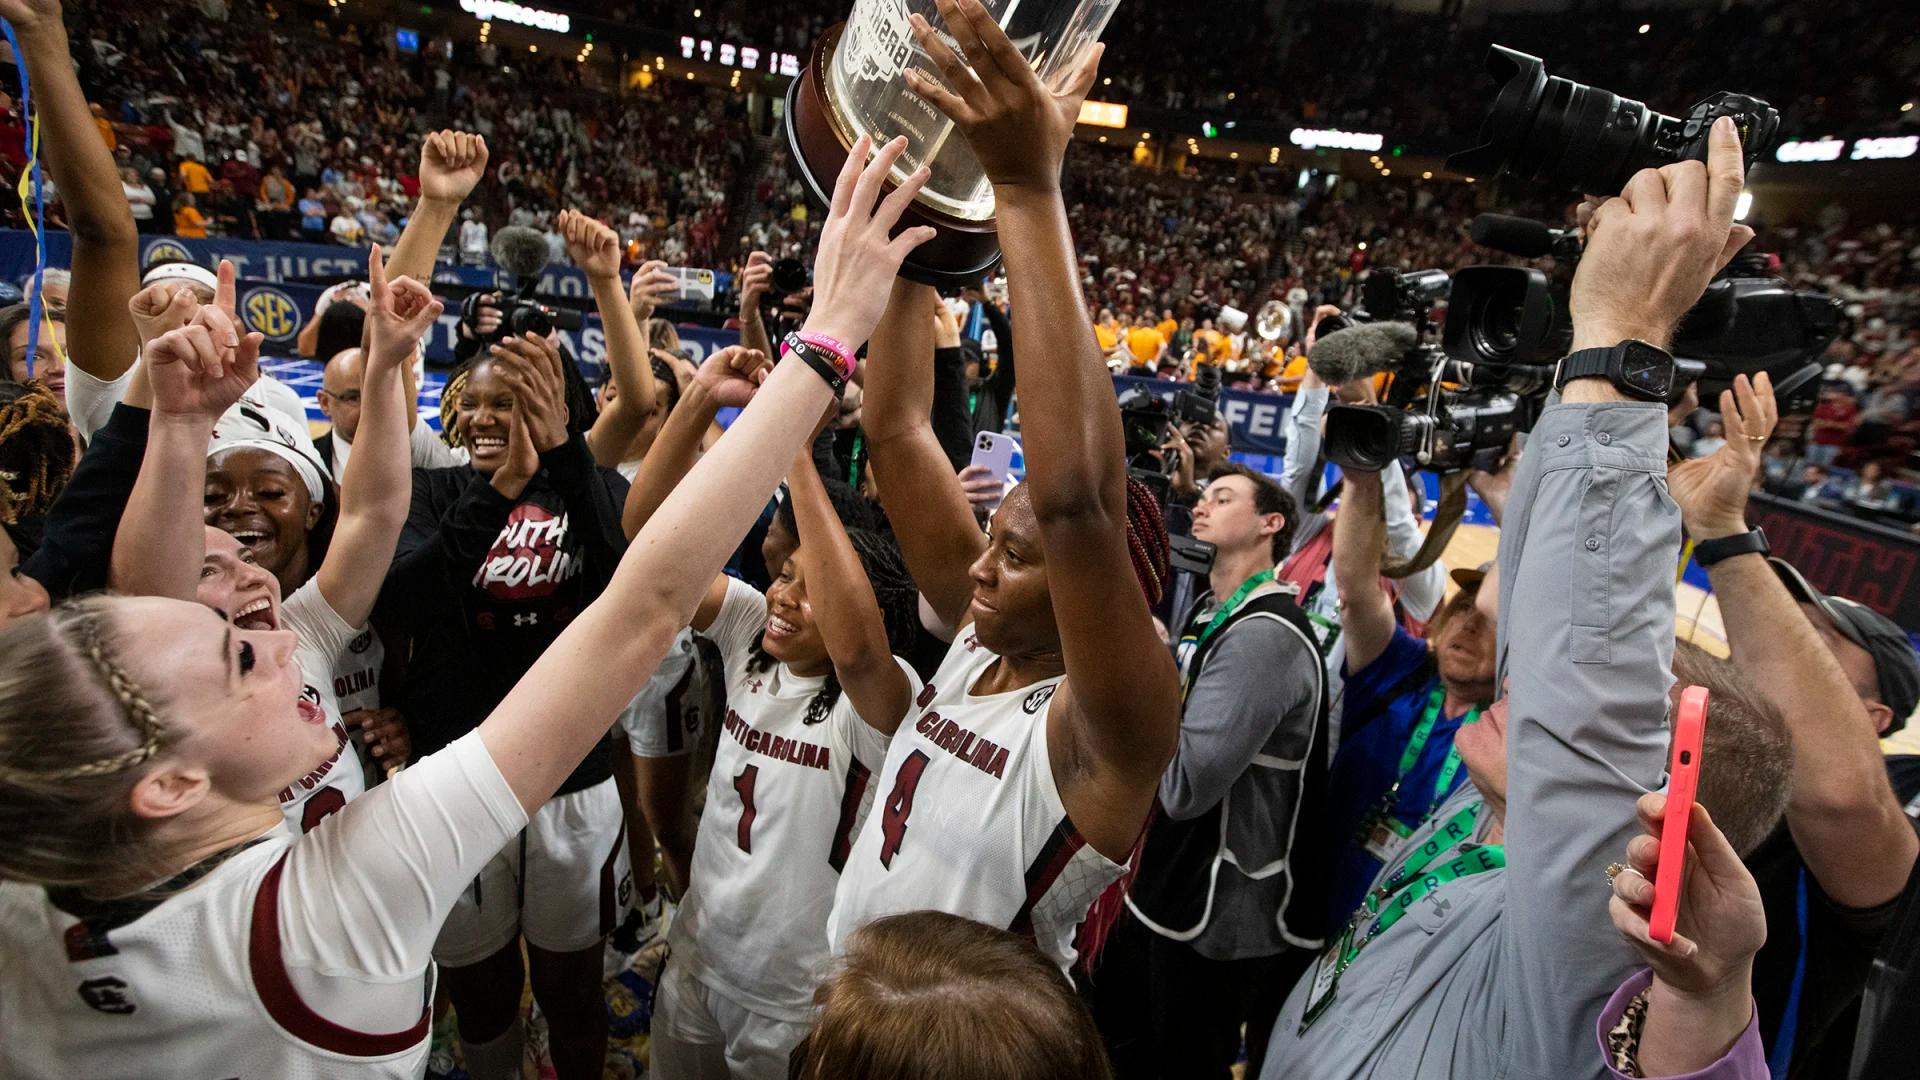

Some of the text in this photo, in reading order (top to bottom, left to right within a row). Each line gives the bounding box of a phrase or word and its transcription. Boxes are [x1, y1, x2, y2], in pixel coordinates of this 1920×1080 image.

[247, 291, 295, 336] SEC
[745, 728, 831, 771] CAROLINA
[916, 710, 1011, 781] CAROLINA
[733, 763, 760, 856] 1
[879, 748, 931, 872] 4
